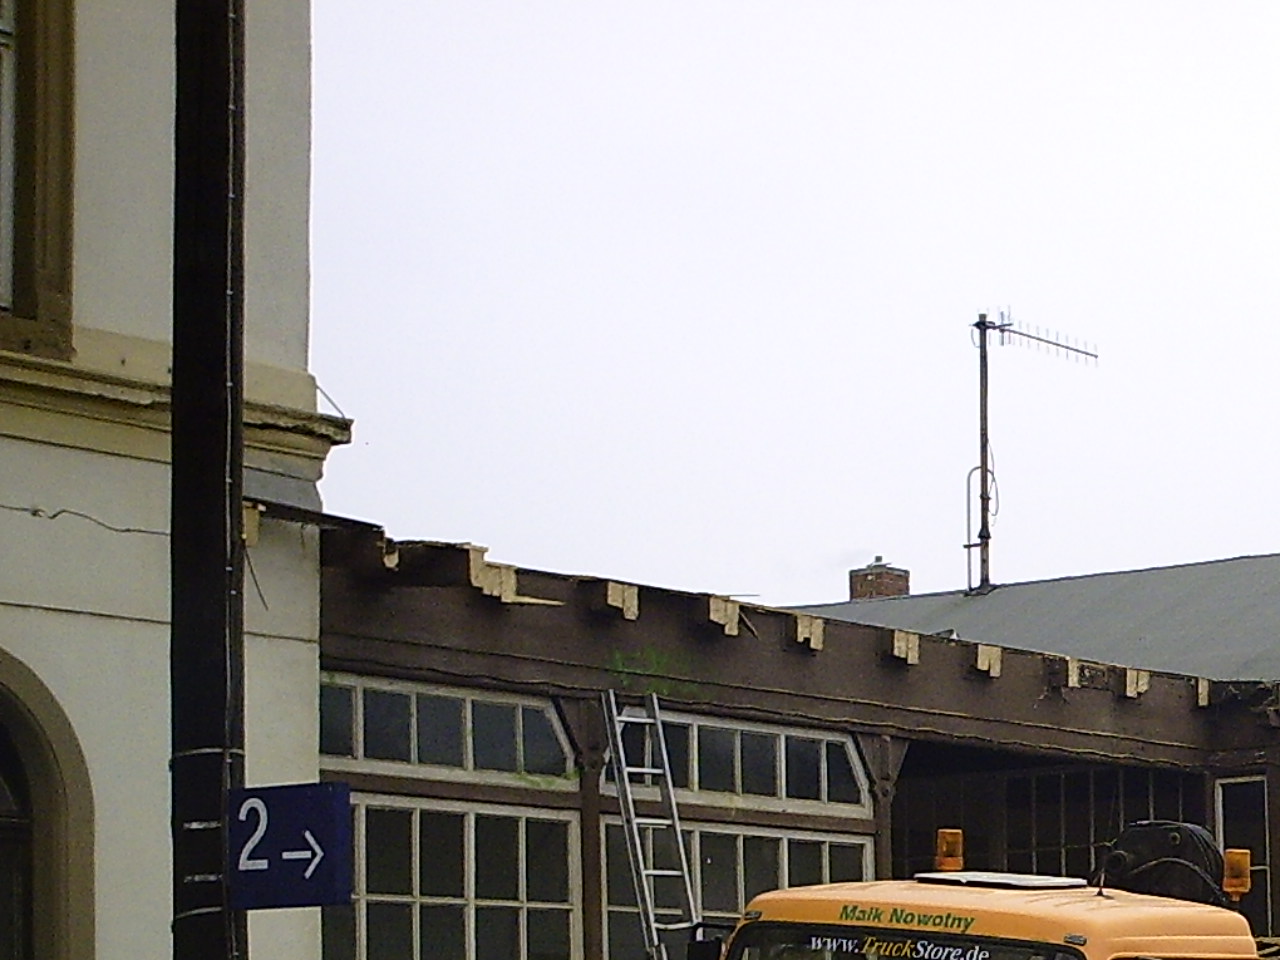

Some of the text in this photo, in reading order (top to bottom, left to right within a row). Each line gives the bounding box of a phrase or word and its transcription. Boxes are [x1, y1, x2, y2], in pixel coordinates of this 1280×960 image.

[237, 796, 270, 871] 2
[839, 904, 975, 933] Maik Nowotny
